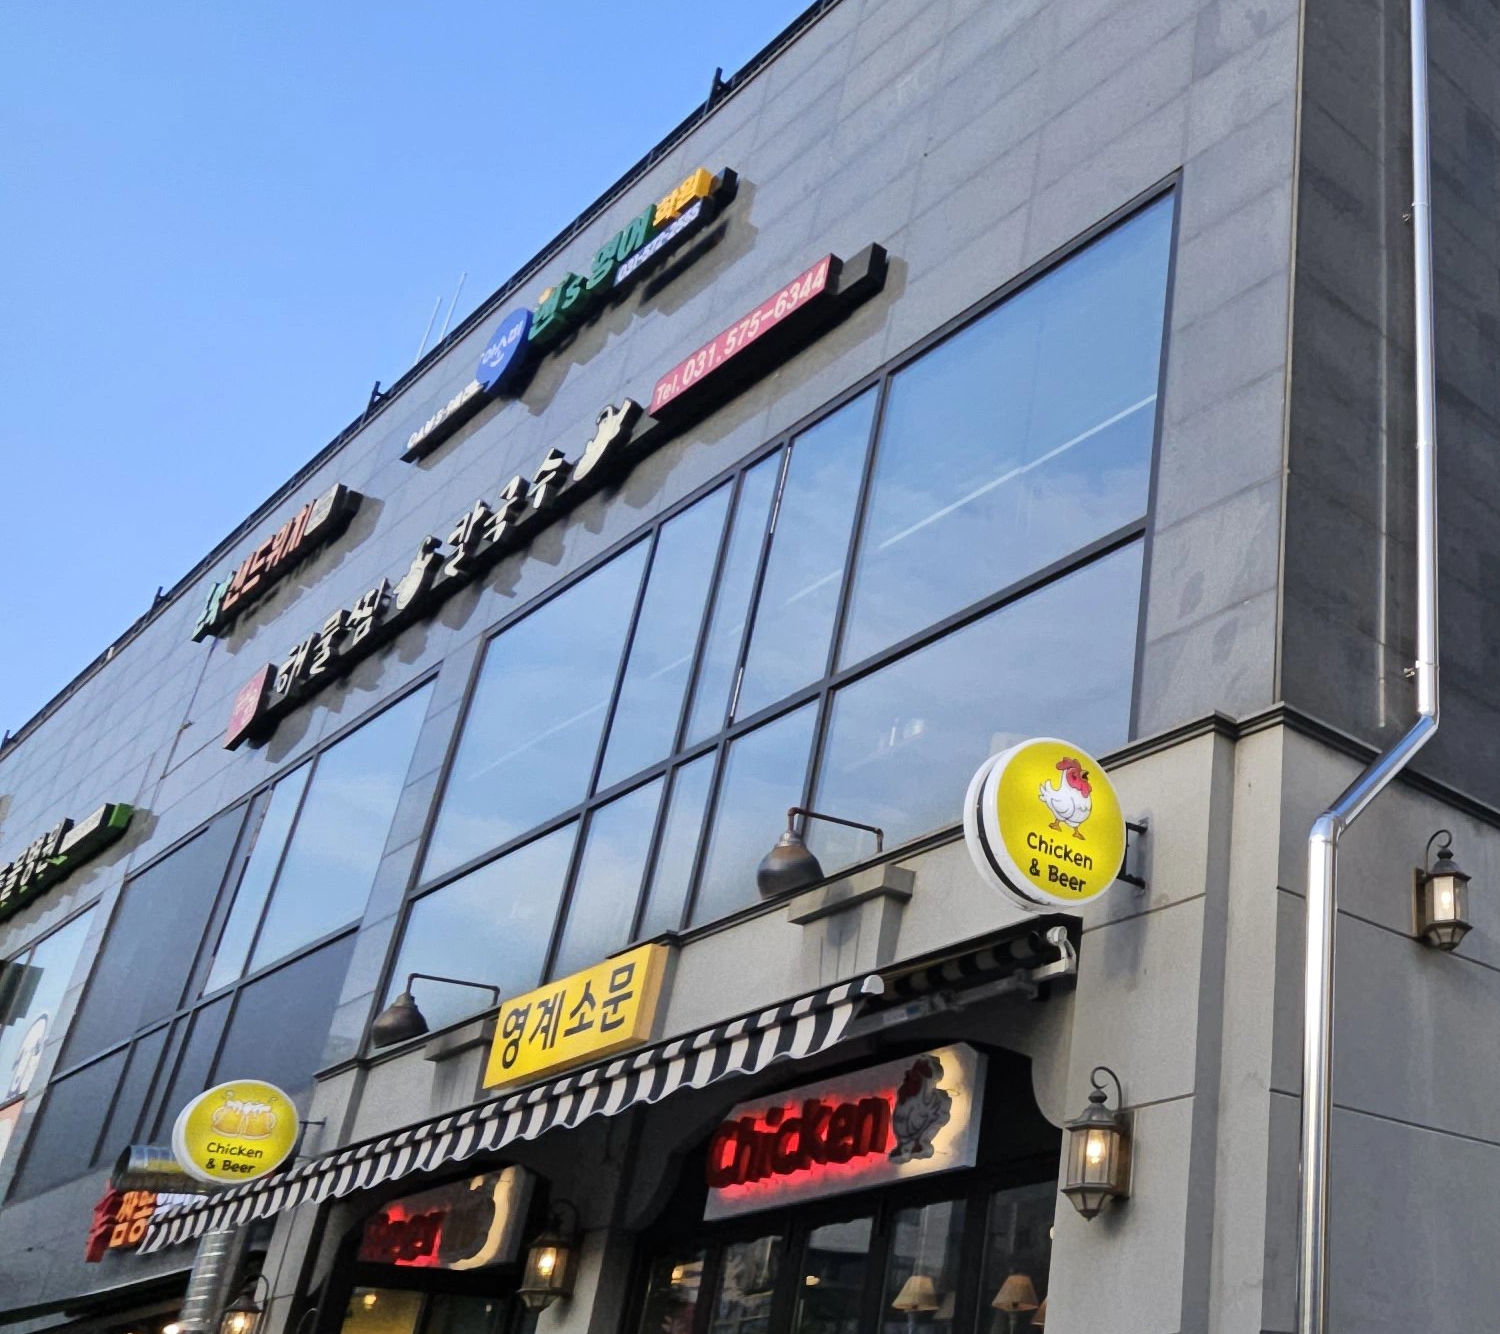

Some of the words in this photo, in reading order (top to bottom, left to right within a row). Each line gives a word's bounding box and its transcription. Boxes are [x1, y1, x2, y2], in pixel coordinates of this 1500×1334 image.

[222, 499, 318, 611] 샌드위치
[277, 578, 391, 693] 해물찜
[445, 448, 563, 577] 칼국수
[1026, 831, 1093, 871] Chicken
[1028, 858, 1041, 878] &
[1047, 864, 1087, 893] Beer
[502, 962, 636, 1069] 영계소문
[206, 1158, 215, 1171] &
[222, 1159, 256, 1174] Beer
[207, 1142, 263, 1159] Chicken
[707, 1097, 890, 1189] Chicken
